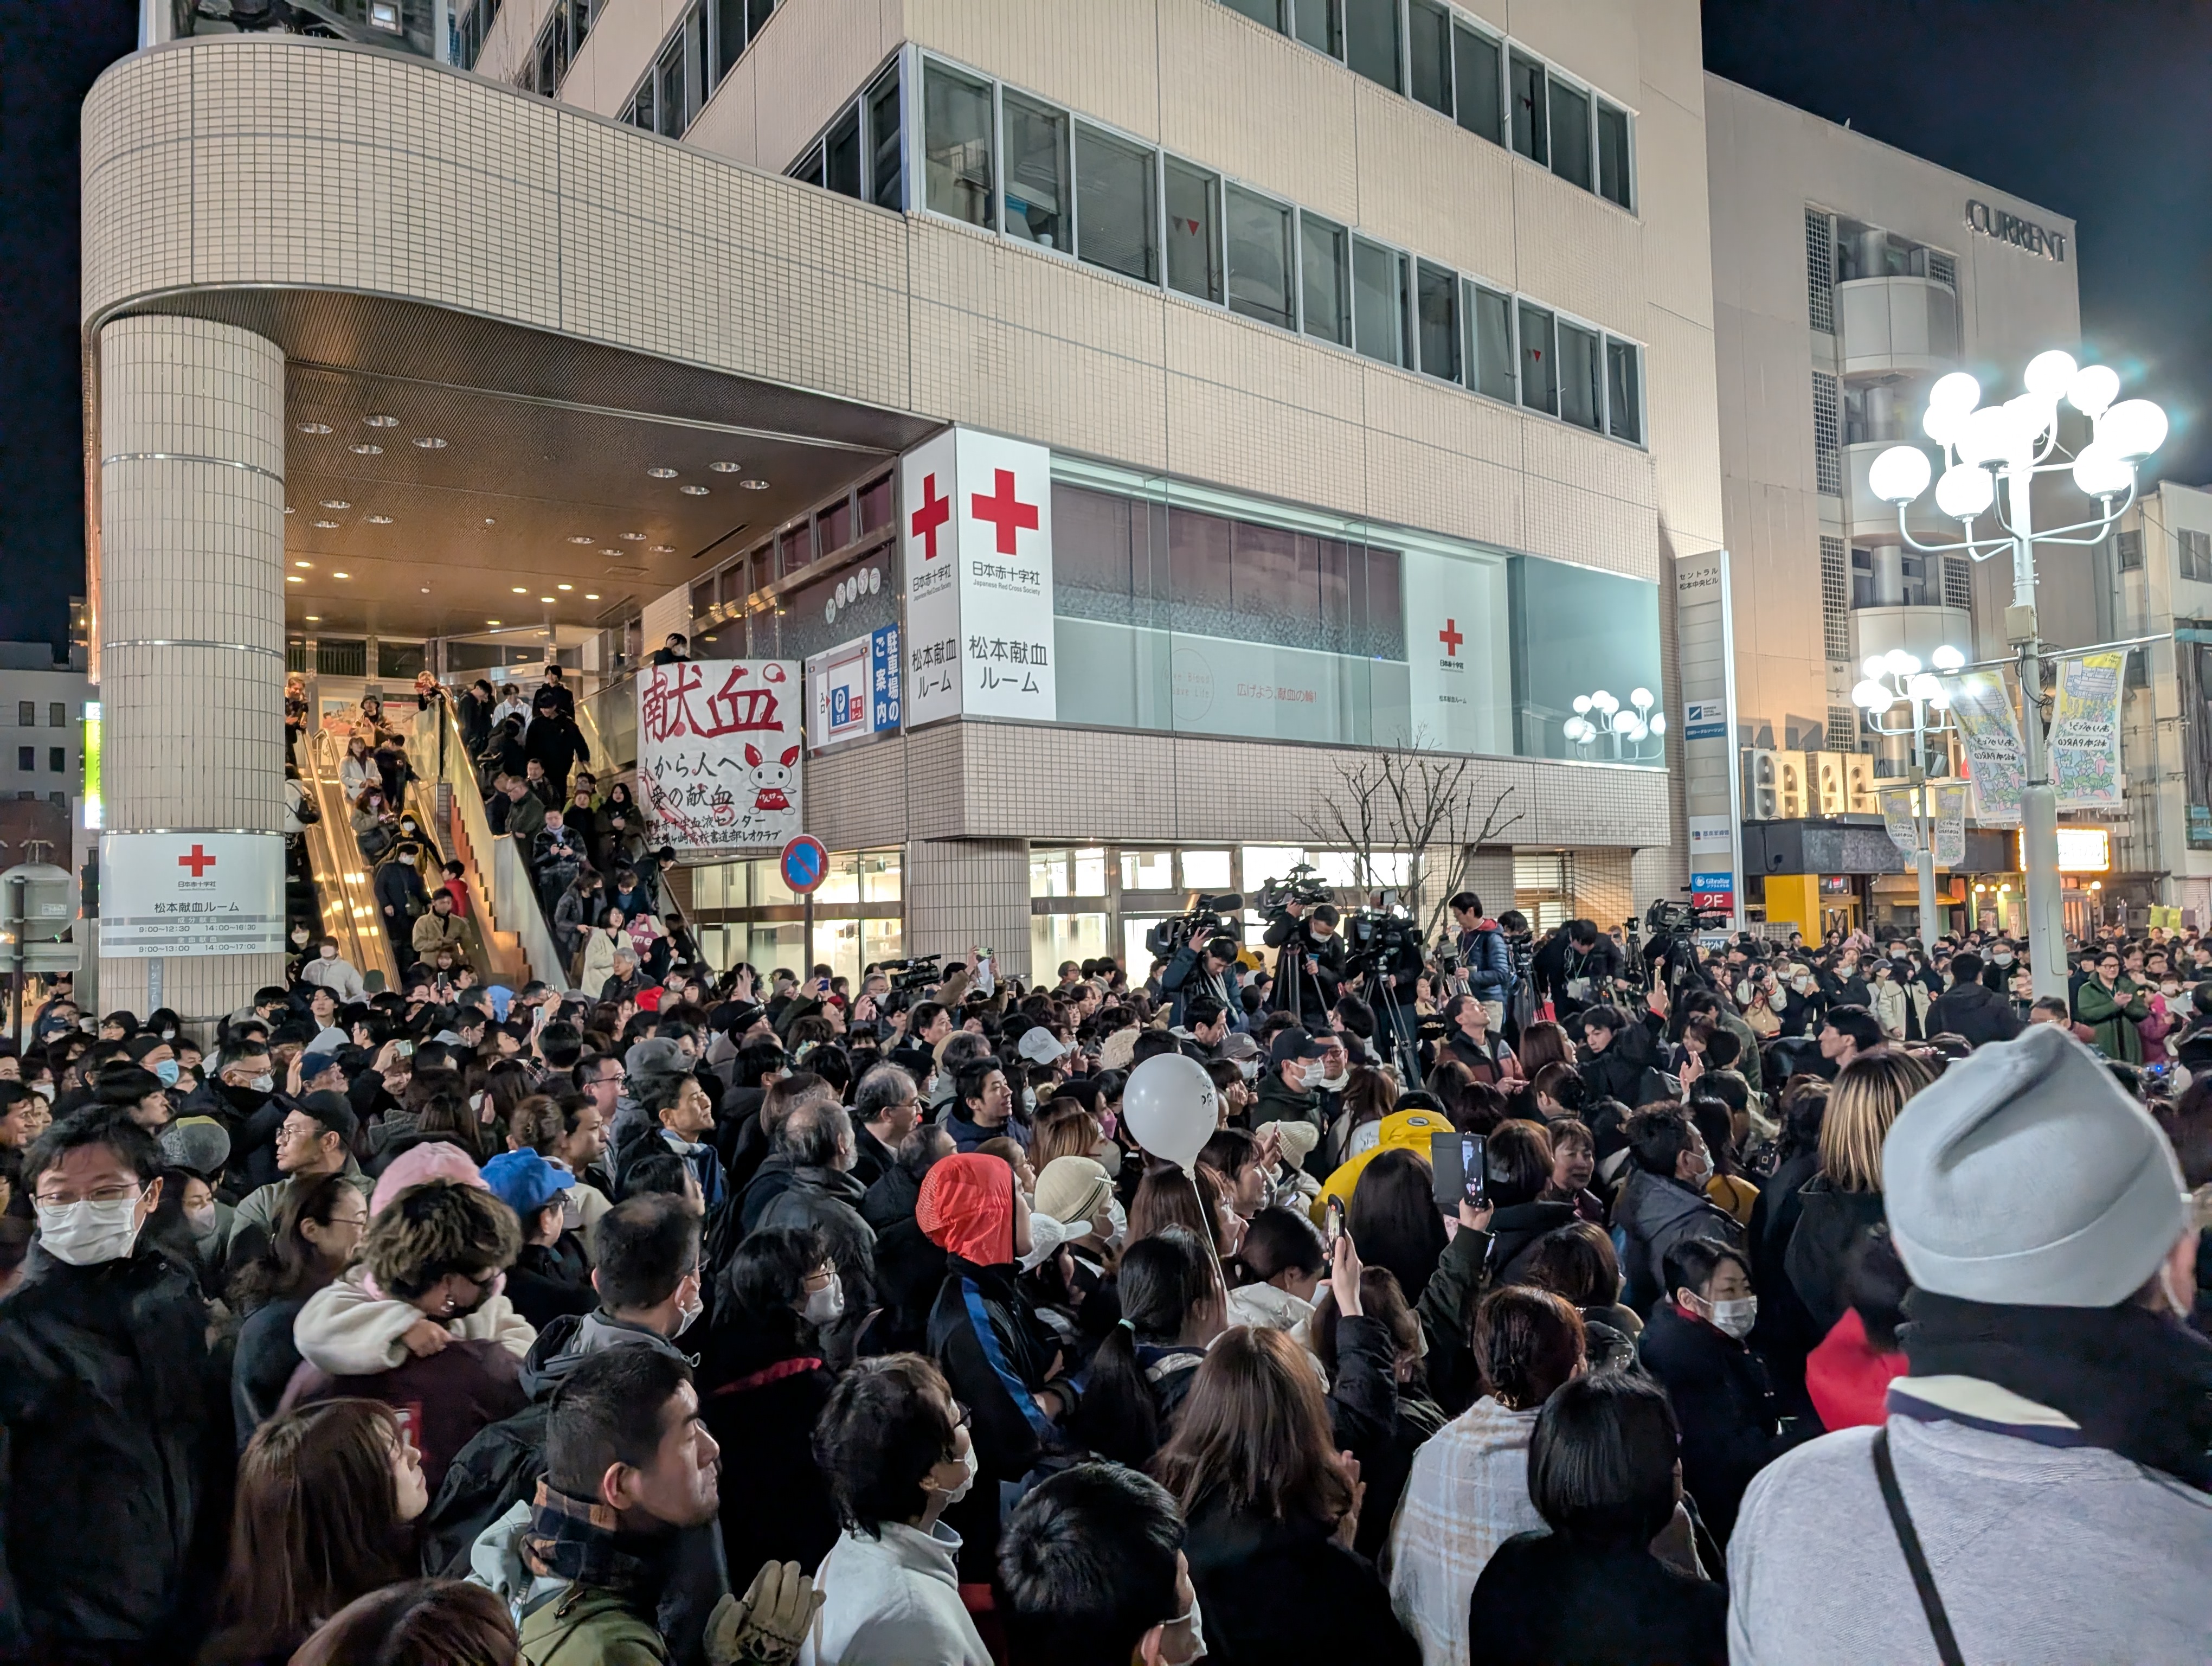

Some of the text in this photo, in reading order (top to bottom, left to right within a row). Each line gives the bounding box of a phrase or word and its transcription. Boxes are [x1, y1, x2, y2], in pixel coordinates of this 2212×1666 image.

[1965, 198, 2066, 262] CURRENT
[913, 563, 951, 593] 日本赤十字社
[973, 561, 1040, 585] 日本赤十字社
[1680, 567, 1718, 580] セントラル
[1680, 577, 1719, 590] 松本中央ビル
[973, 579, 1040, 597] Japanese Red Cross Society
[912, 638, 957, 673] 松本献血
[969, 635, 1049, 667] 松本献血
[875, 636, 887, 726] ご案内
[887, 631, 899, 722] 駐車場の
[918, 669, 952, 700] ルーム
[980, 667, 1040, 694] ルーム
[642, 662, 785, 745] 献血
[820, 691, 825, 714] 入口
[642, 752, 743, 782] 人から人へ
[651, 784, 735, 812] 愛の献血
[759, 792, 784, 803] けんけつ
[154, 901, 240, 913] 松本献血ルーム
[1703, 894, 1724, 907] 2F
